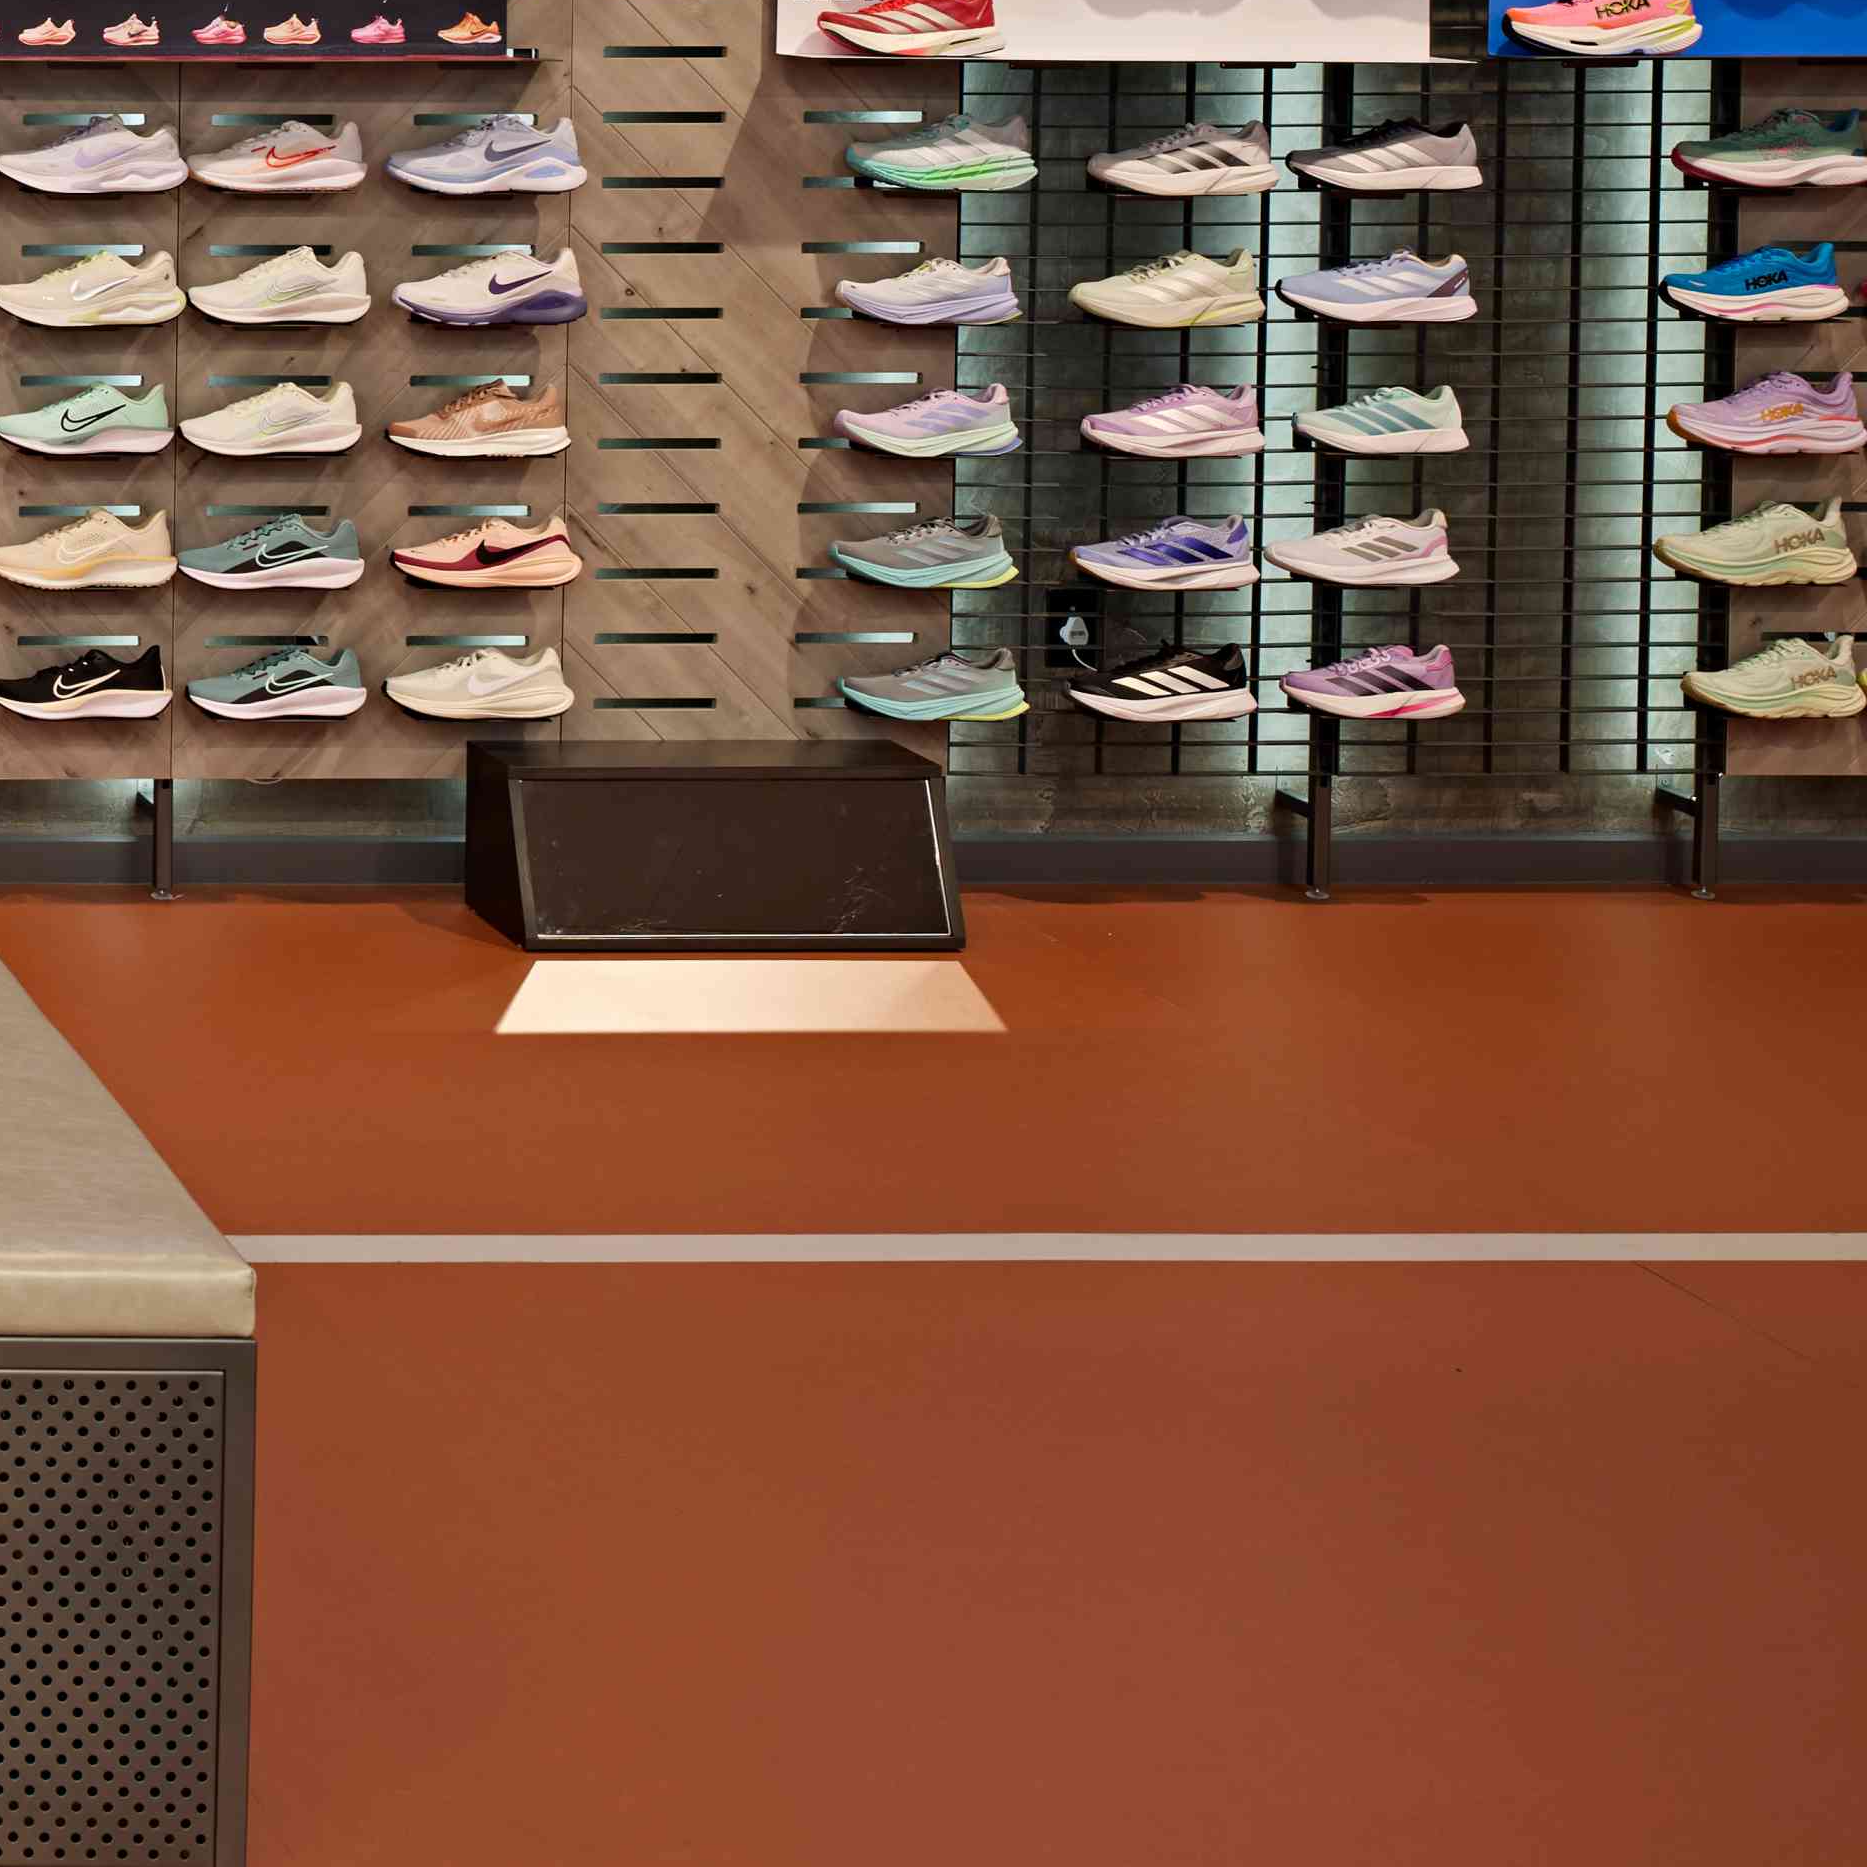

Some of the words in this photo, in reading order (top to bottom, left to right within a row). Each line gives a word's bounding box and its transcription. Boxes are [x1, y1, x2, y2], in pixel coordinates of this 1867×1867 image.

[1744, 268, 1789, 290] HOKA
[1773, 527, 1825, 554] HOKA
[1790, 665, 1837, 689] HOKA
